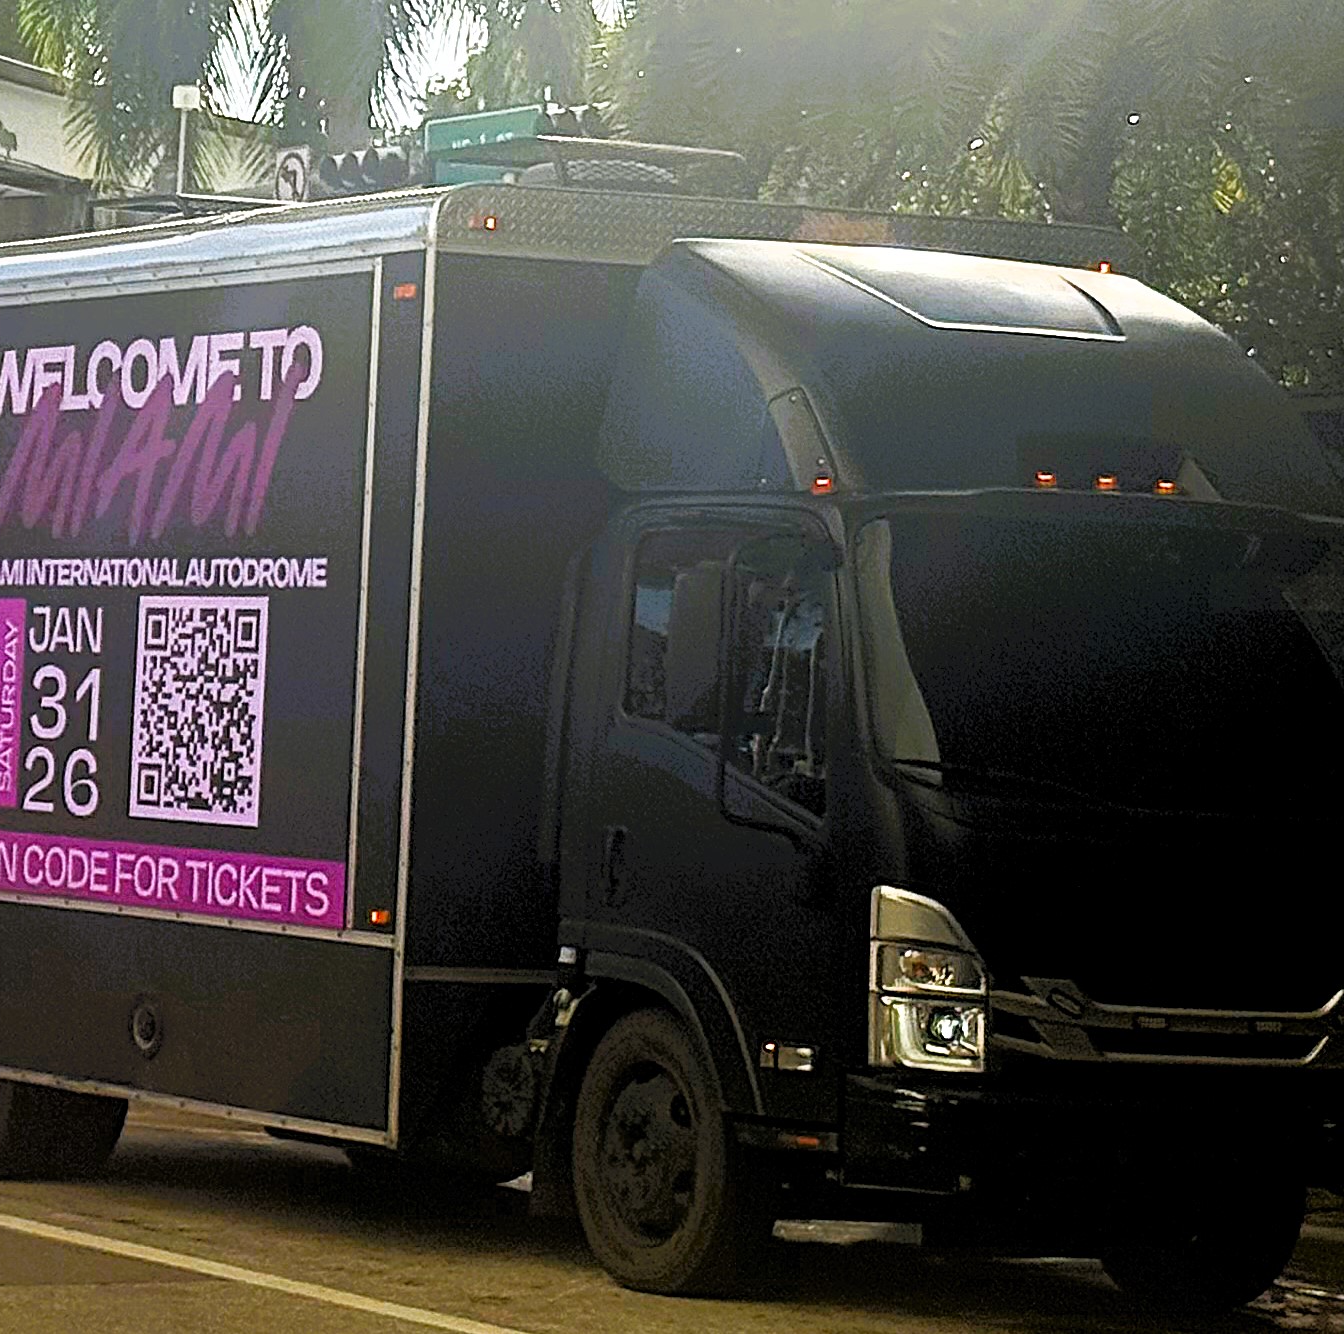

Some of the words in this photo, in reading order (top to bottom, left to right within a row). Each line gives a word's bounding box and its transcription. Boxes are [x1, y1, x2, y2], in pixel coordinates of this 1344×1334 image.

[250, 325, 323, 401] TO
[26, 557, 183, 588] INTERNATIONAL
[185, 557, 327, 588] AUTODROME
[29, 606, 103, 653] JAN
[29, 664, 101, 741] 31
[23, 746, 99, 816] 26
[23, 845, 109, 892] CODE
[114, 855, 178, 901] FOR
[185, 860, 330, 917] TICKETS
